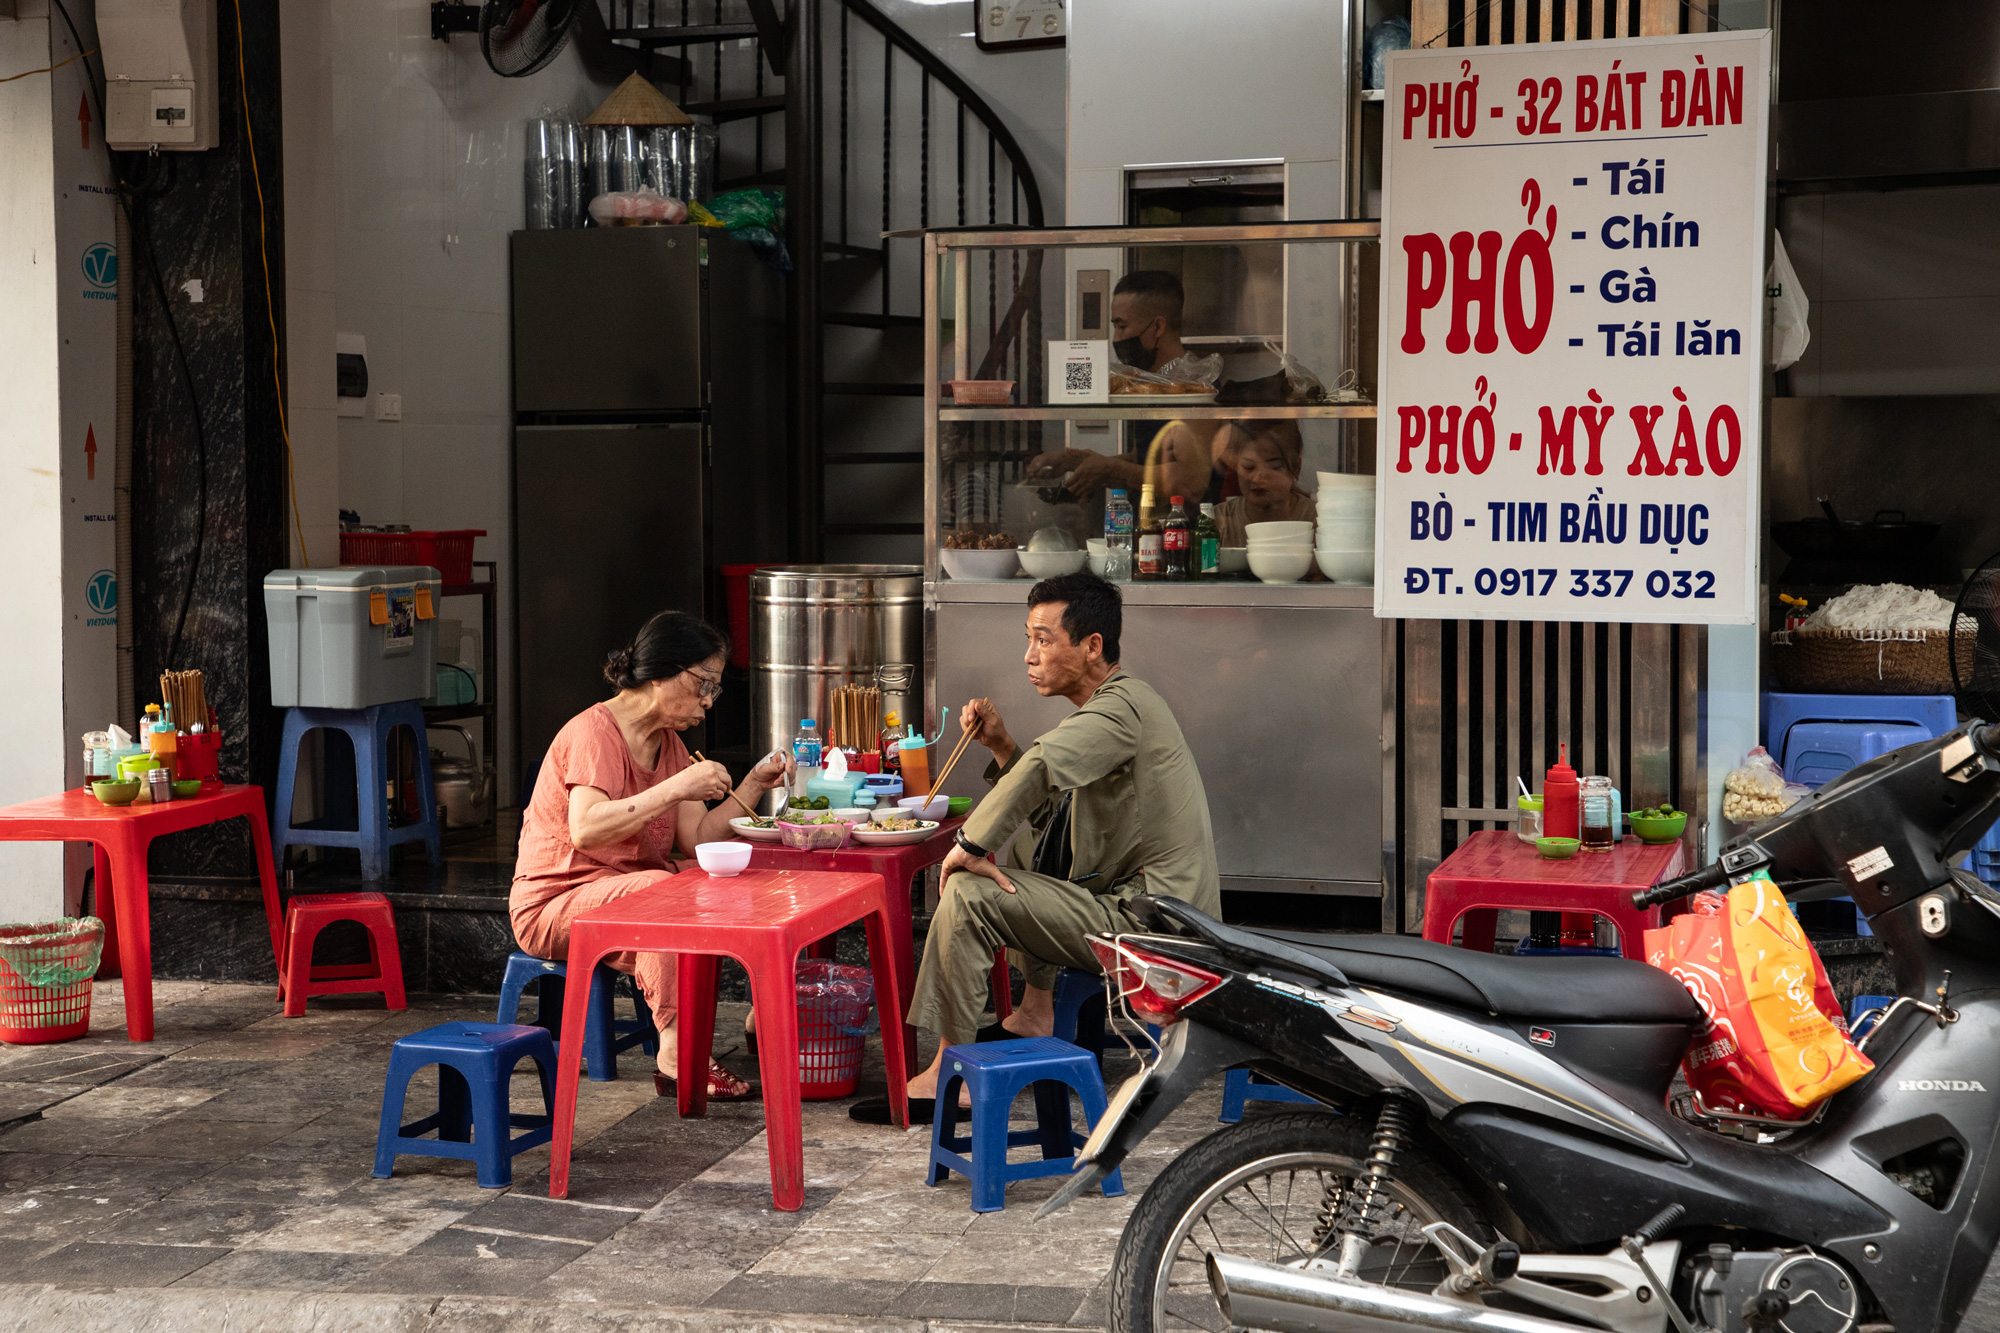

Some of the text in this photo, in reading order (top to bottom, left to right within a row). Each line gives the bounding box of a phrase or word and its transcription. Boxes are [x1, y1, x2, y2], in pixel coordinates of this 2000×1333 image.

[990, 6, 1058, 38] 8 7 6
[1403, 59, 1480, 140] PHỞ
[1516, 77, 1563, 136] 32
[1575, 60, 1647, 133] BÁT
[1660, 54, 1744, 130] ĐÀN
[78, 184, 103, 194] INSTALL
[1601, 158, 1666, 196] Tái
[1600, 211, 1700, 250] Chín
[1401, 178, 1558, 356] PHỞ
[1599, 267, 1657, 304] Gà
[1597, 320, 1660, 357] Tái
[1675, 319, 1741, 356] lăn
[1396, 375, 1498, 475] PHỞ
[1536, 388, 1615, 476] MỲ
[1626, 386, 1742, 477] XÀO
[84, 514, 106, 522] INSTALL
[1410, 492, 1453, 541] BÒ
[1487, 502, 1548, 543] TIM
[1559, 486, 1628, 544] BẦU
[1639, 503, 1710, 555] DỤC
[1404, 567, 1717, 599] ĐT. 0917 337 032
[1897, 1079, 1987, 1092] HONDA
